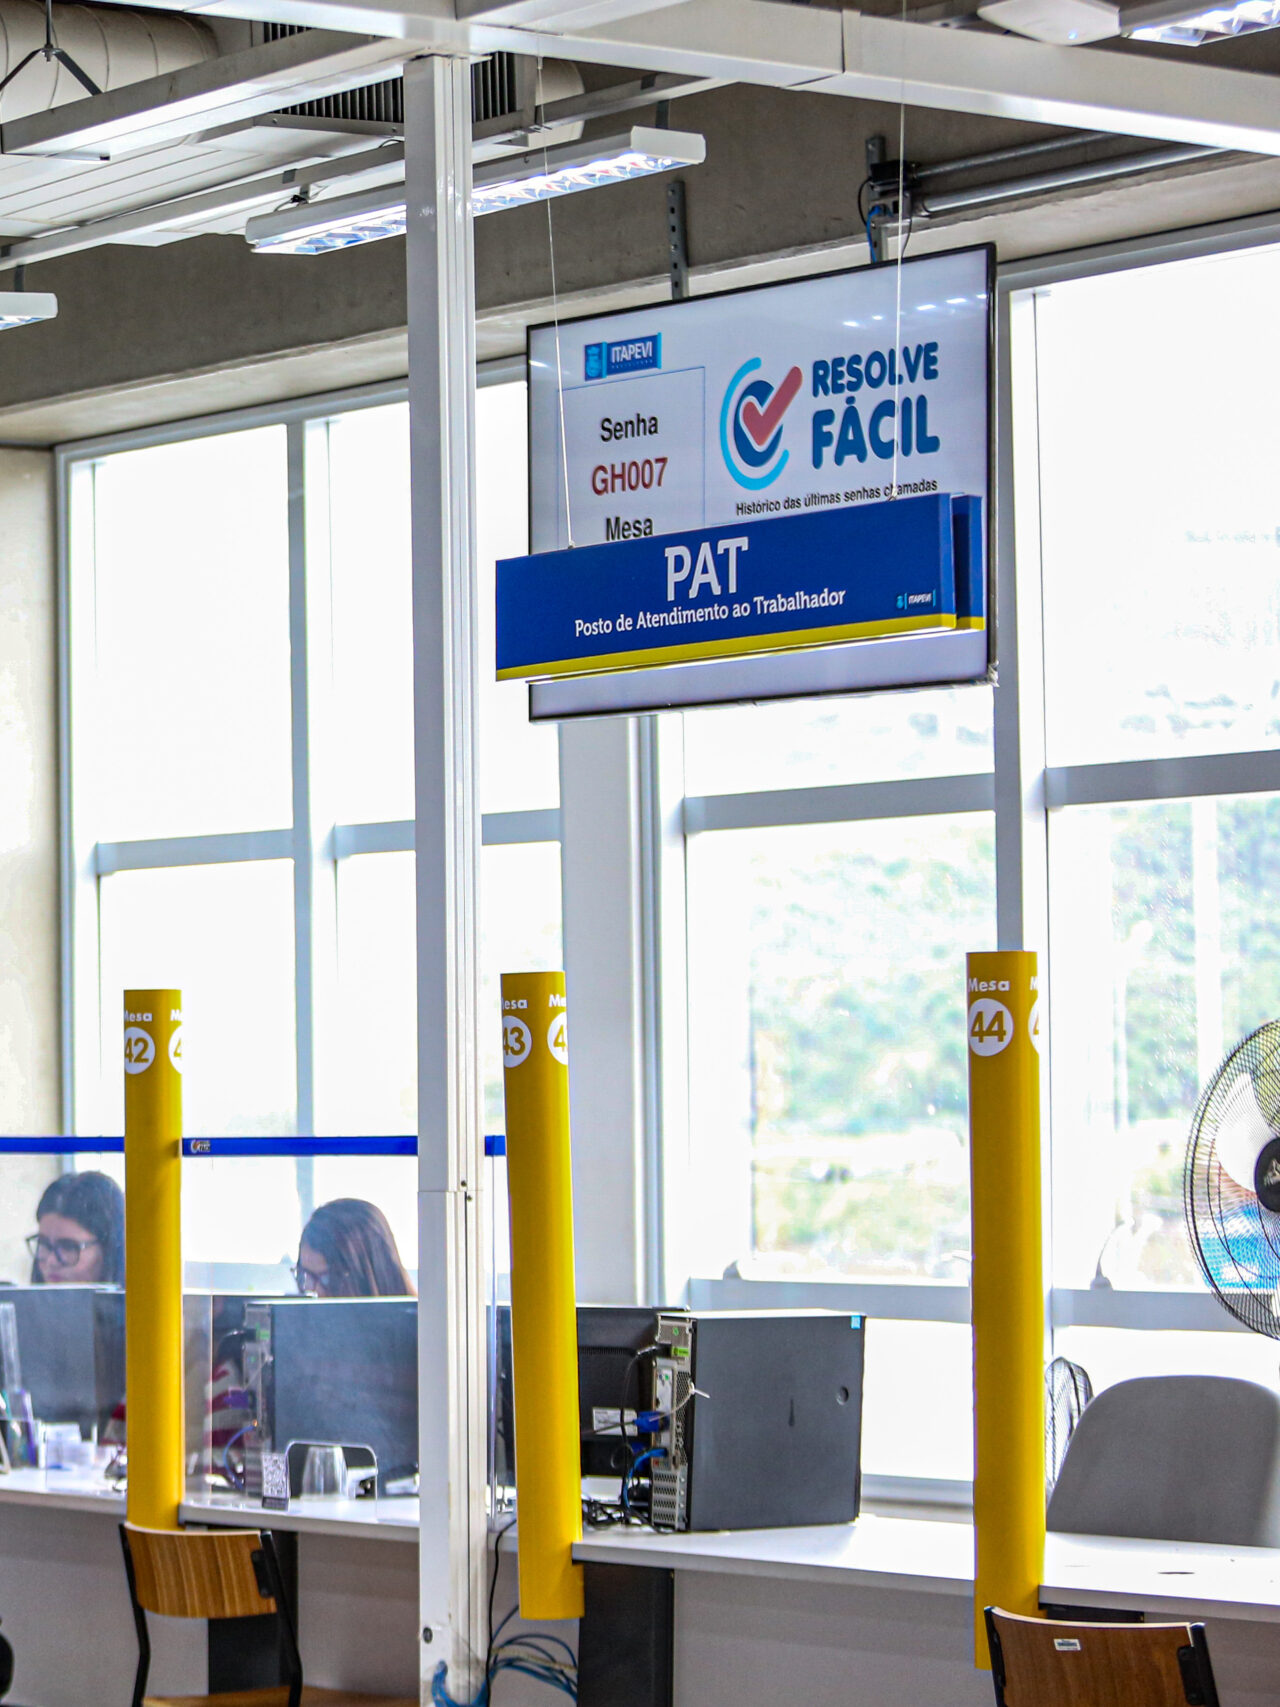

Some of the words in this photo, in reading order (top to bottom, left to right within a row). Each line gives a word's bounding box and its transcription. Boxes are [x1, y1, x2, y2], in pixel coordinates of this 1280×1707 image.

[611, 341, 653, 364] ITAPEVI
[812, 341, 939, 398] RESOLVE
[600, 413, 659, 442] Senha
[812, 395, 940, 470] FÁCIL
[592, 457, 669, 496] GH007
[736, 501, 781, 516] Histórico
[783, 497, 802, 510] das
[804, 491, 841, 508] últimas
[844, 486, 881, 502] senhas
[605, 516, 654, 541] Mesa
[664, 536, 749, 601] PAT
[575, 618, 612, 637] Posto
[616, 614, 633, 632] de
[636, 603, 729, 630] Atendimento
[732, 602, 751, 618] ao
[753, 588, 846, 615] Trabalhador
[968, 977, 1010, 992] Mesa
[970, 1010, 1007, 1043] 44
[125, 1037, 149, 1064] 42
